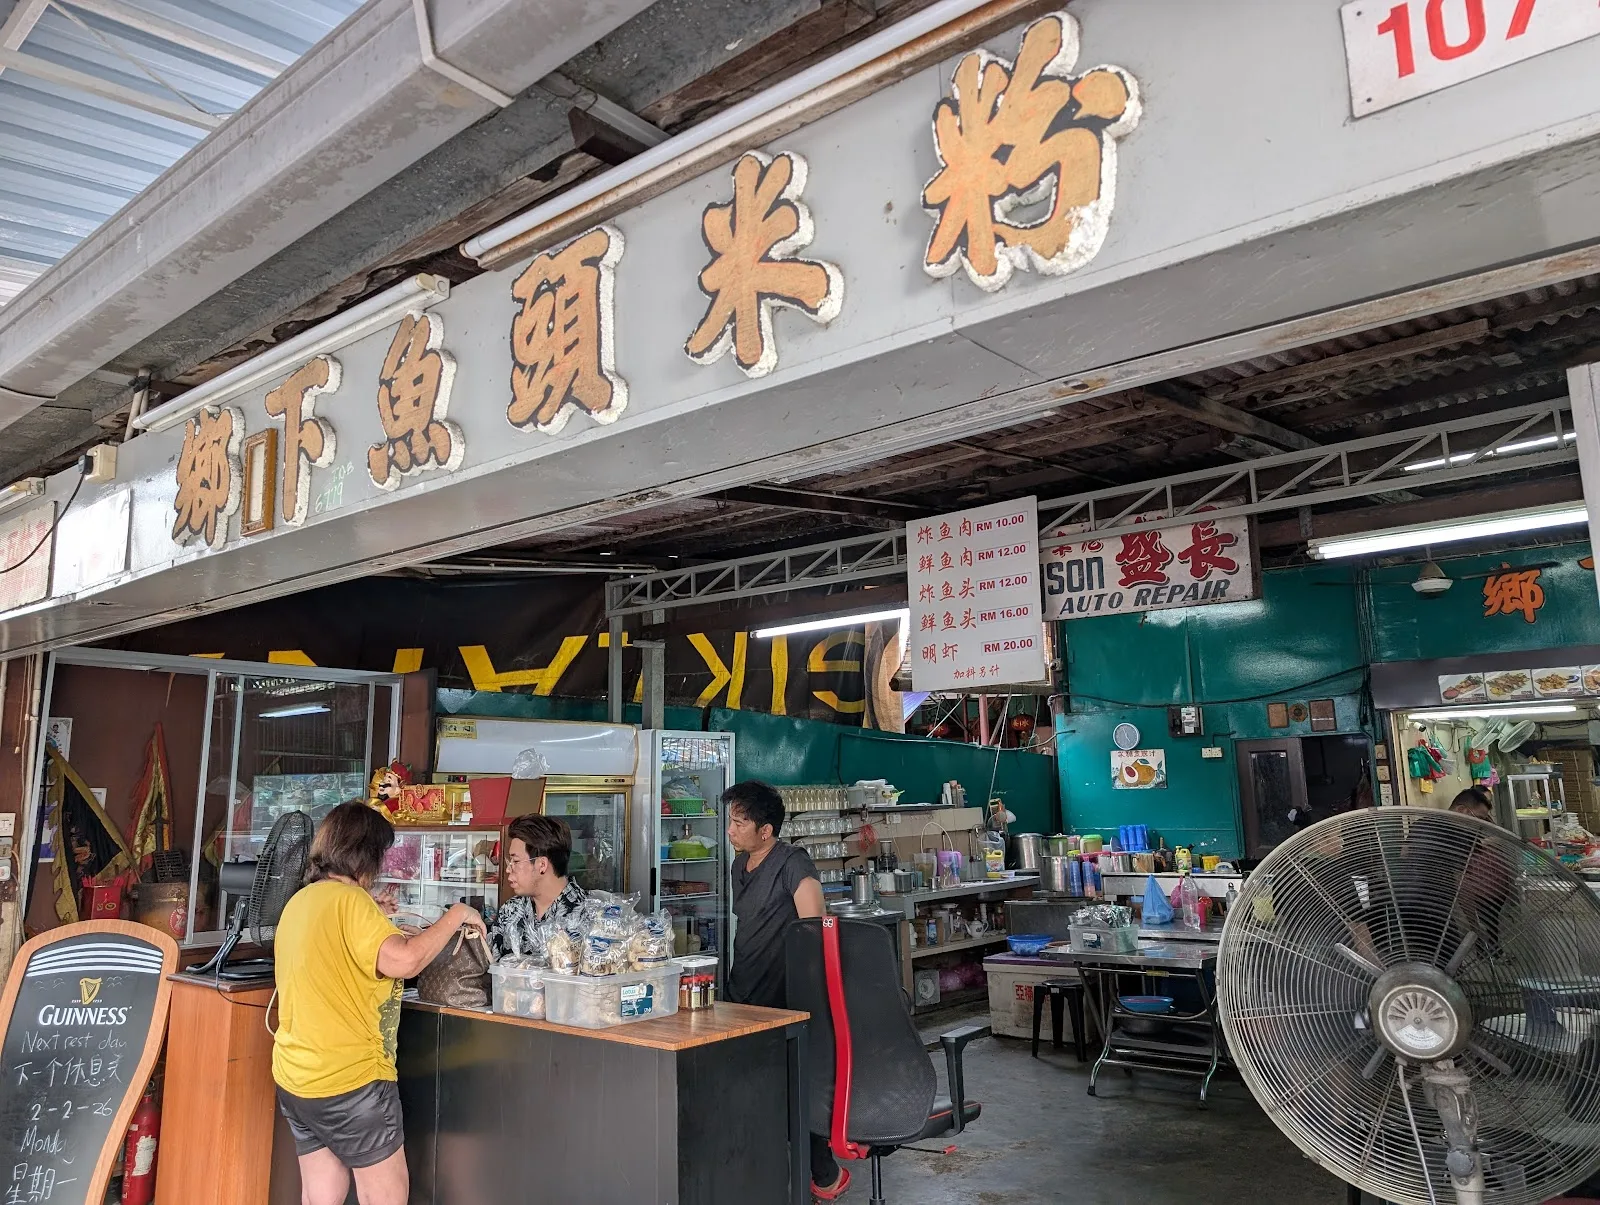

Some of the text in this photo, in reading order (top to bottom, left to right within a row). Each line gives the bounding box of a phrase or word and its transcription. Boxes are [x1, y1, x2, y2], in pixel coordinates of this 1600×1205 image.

[917, 514, 1024, 545] 炸鱼肉 RM 10.00
[918, 544, 1026, 575] 鲜鱼肉 RM 12.00
[919, 575, 1028, 604] 炸鱼头 RM 12.00
[1060, 578, 1231, 615] AUTO REPAIR
[920, 606, 1029, 635] 鲜鱼头 RM 16.00
[922, 638, 1033, 665] 明虾 RM 20.00
[38, 1004, 128, 1026] GUINNESS
[21, 1030, 60, 1053] Next
[64, 1032, 93, 1050] rest
[31, 1097, 113, 1121] 2-2-26
[5, 1162, 78, 1205] 星期一
